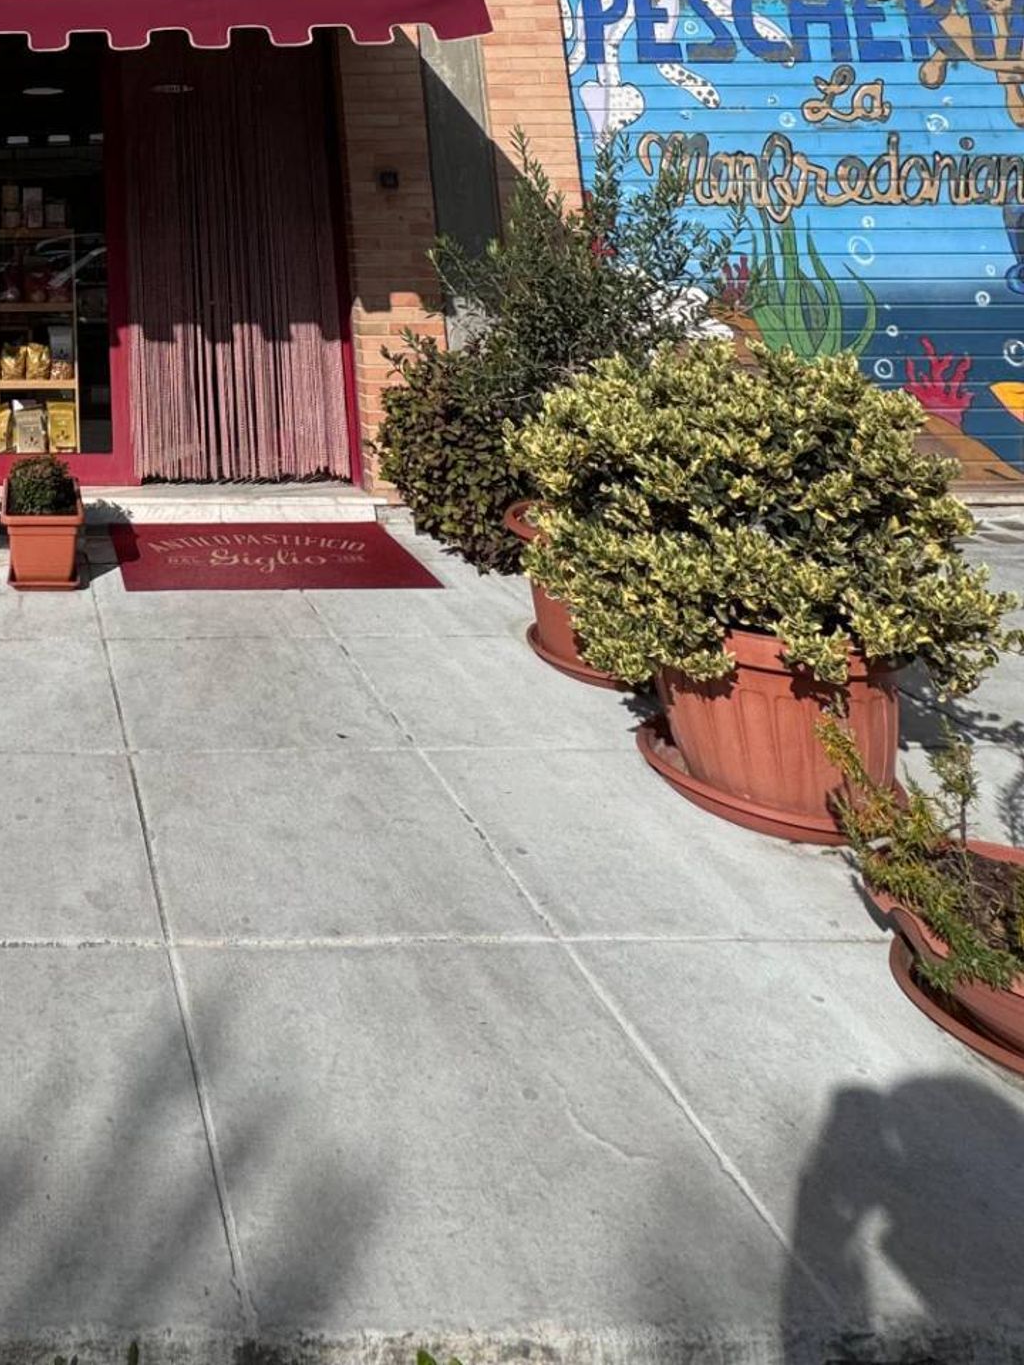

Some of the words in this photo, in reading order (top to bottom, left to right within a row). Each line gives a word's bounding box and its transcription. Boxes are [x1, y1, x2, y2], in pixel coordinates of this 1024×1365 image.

[801, 65, 892, 123] La
[232, 533, 367, 552] PASTIFICIO
[208, 547, 328, 574] Giglio
